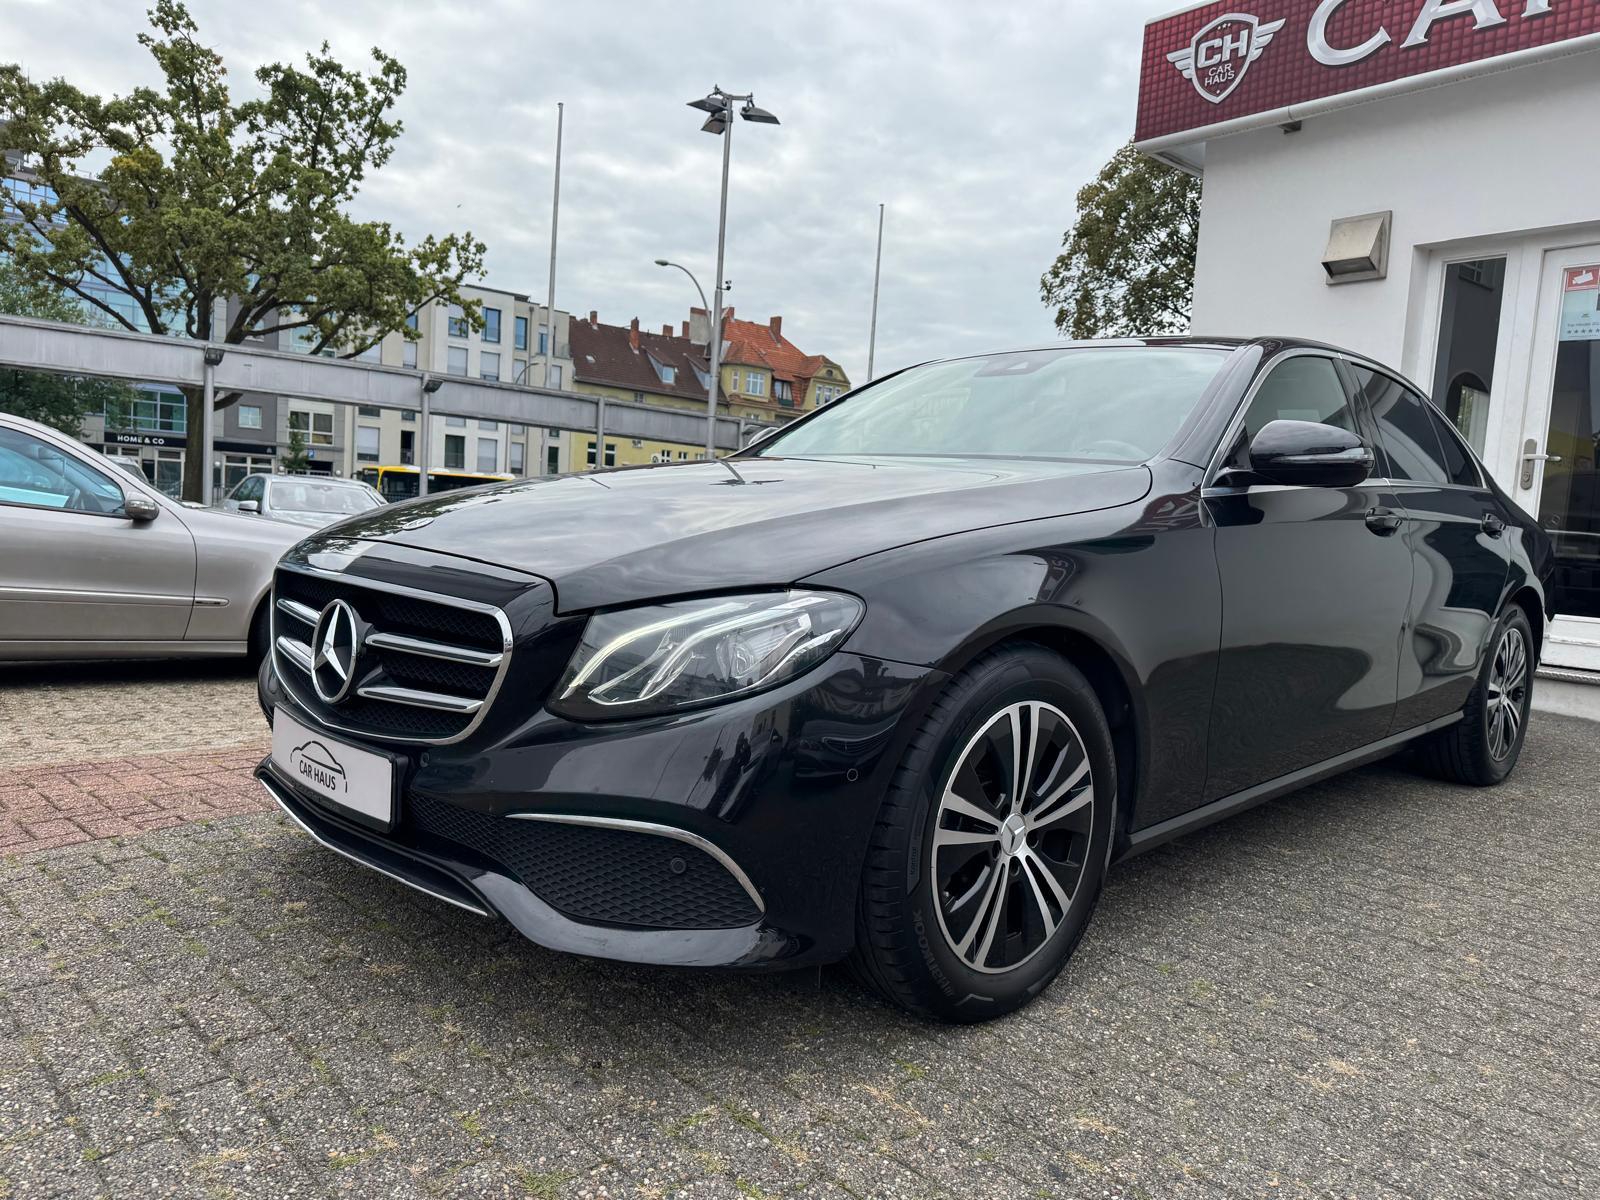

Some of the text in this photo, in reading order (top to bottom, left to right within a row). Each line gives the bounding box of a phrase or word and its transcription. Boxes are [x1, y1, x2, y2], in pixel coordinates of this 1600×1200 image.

[1307, 0, 1553, 66] CA
[1197, 29, 1249, 68] CH
[1204, 71, 1235, 86] HAUS
[1208, 63, 1232, 77] CAR
[117, 435, 143, 444] HOME
[152, 437, 165, 445] CO
[299, 760, 335, 790] CAR HAUS
